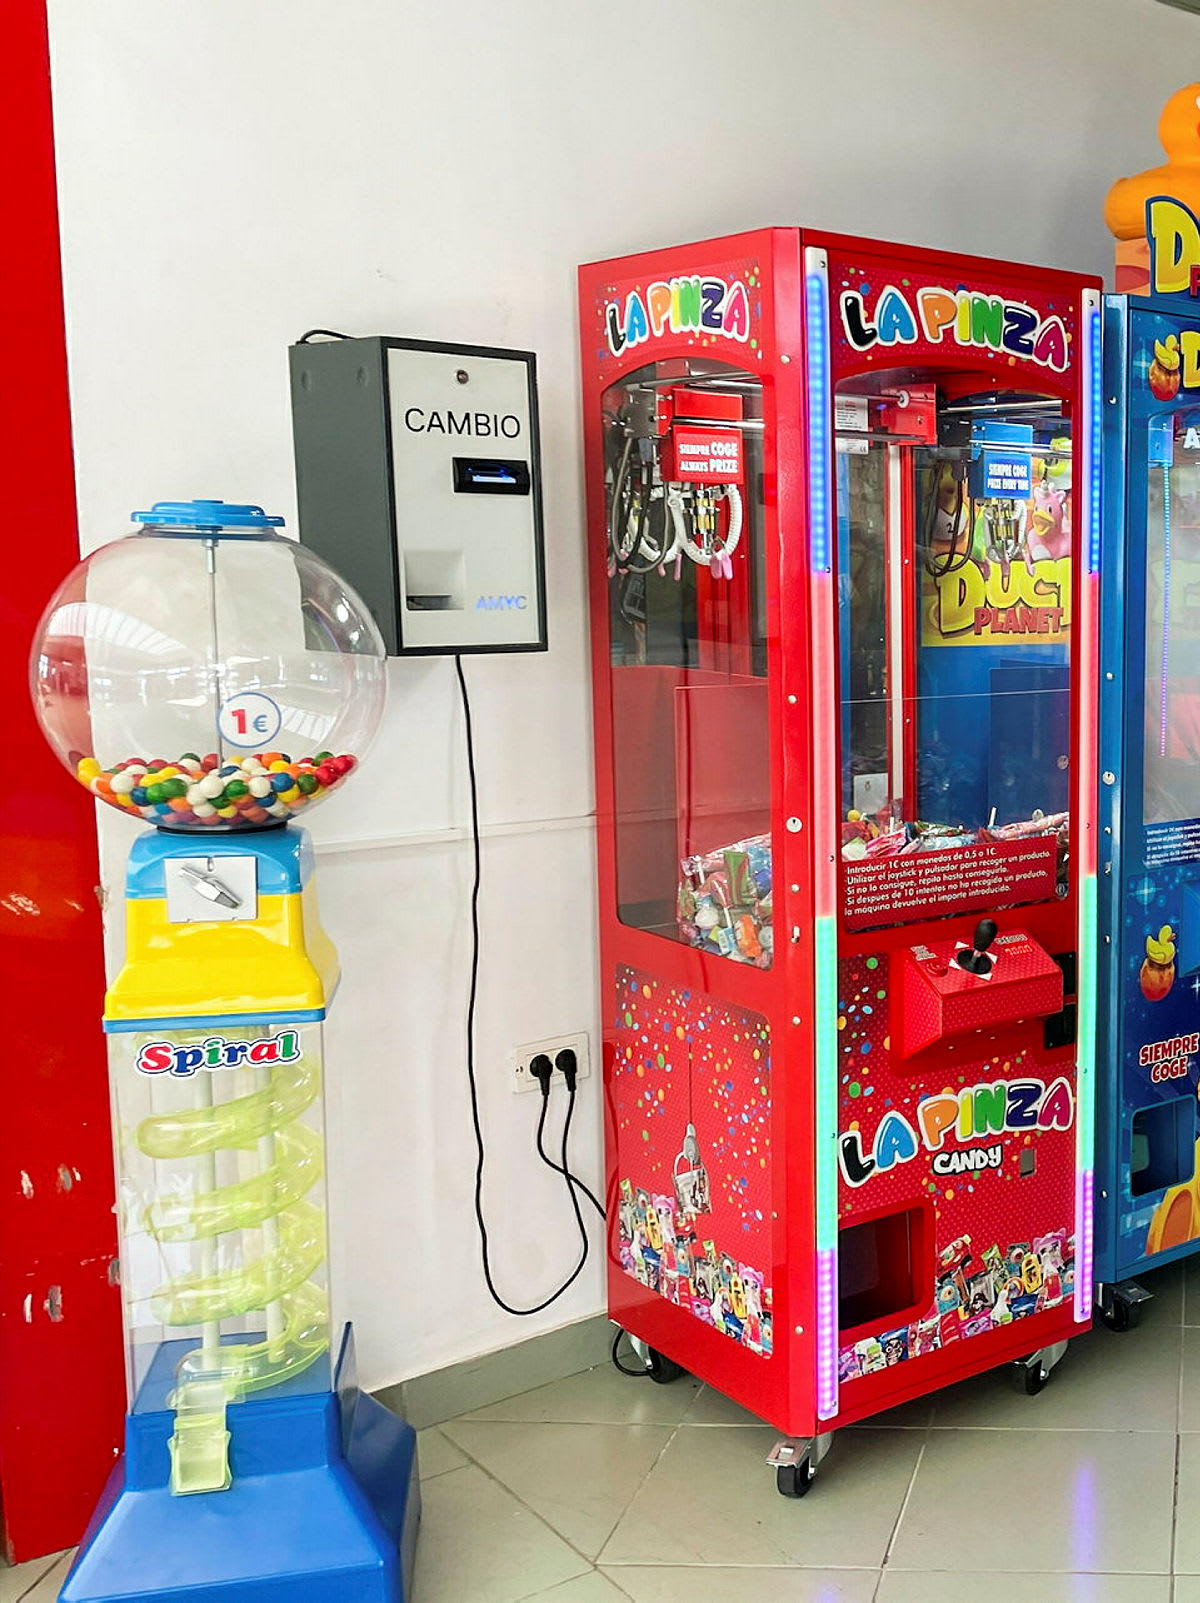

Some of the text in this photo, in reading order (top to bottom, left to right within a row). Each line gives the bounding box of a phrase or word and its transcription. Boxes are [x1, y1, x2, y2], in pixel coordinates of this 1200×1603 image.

[607, 275, 750, 356] LA PINZA
[840, 286, 1068, 372] LA PINZA
[405, 407, 520, 439] CAMBIO
[711, 442, 739, 457] COGE
[709, 459, 739, 473] PRIZE
[974, 607, 1063, 635] PLANET
[878, 872, 886, 881] el
[887, 869, 917, 881] joystick
[925, 863, 958, 875] pulsador
[960, 861, 977, 871] para
[979, 857, 1007, 867] recoger
[900, 860, 915, 868] con
[916, 855, 951, 866] monedas
[953, 852, 963, 860] de
[856, 886, 868, 894] no
[869, 884, 878, 892] lo
[943, 871, 963, 881] hasta
[891, 891, 902, 899] de
[904, 888, 915, 897] 10
[916, 884, 946, 896] intentos
[948, 882, 958, 890] no
[960, 880, 969, 888] ha
[971, 876, 1003, 887] recogido
[892, 897, 927, 909] devuelve
[929, 894, 937, 903] el
[938, 890, 967, 903] importe
[138, 1031, 299, 1075] Spiral
[1140, 1033, 1199, 1065] SIEMPRE
[1152, 1056, 1188, 1082] COGE
[839, 1077, 1073, 1187] LA PINZA
[934, 1144, 1003, 1176] CANDY
